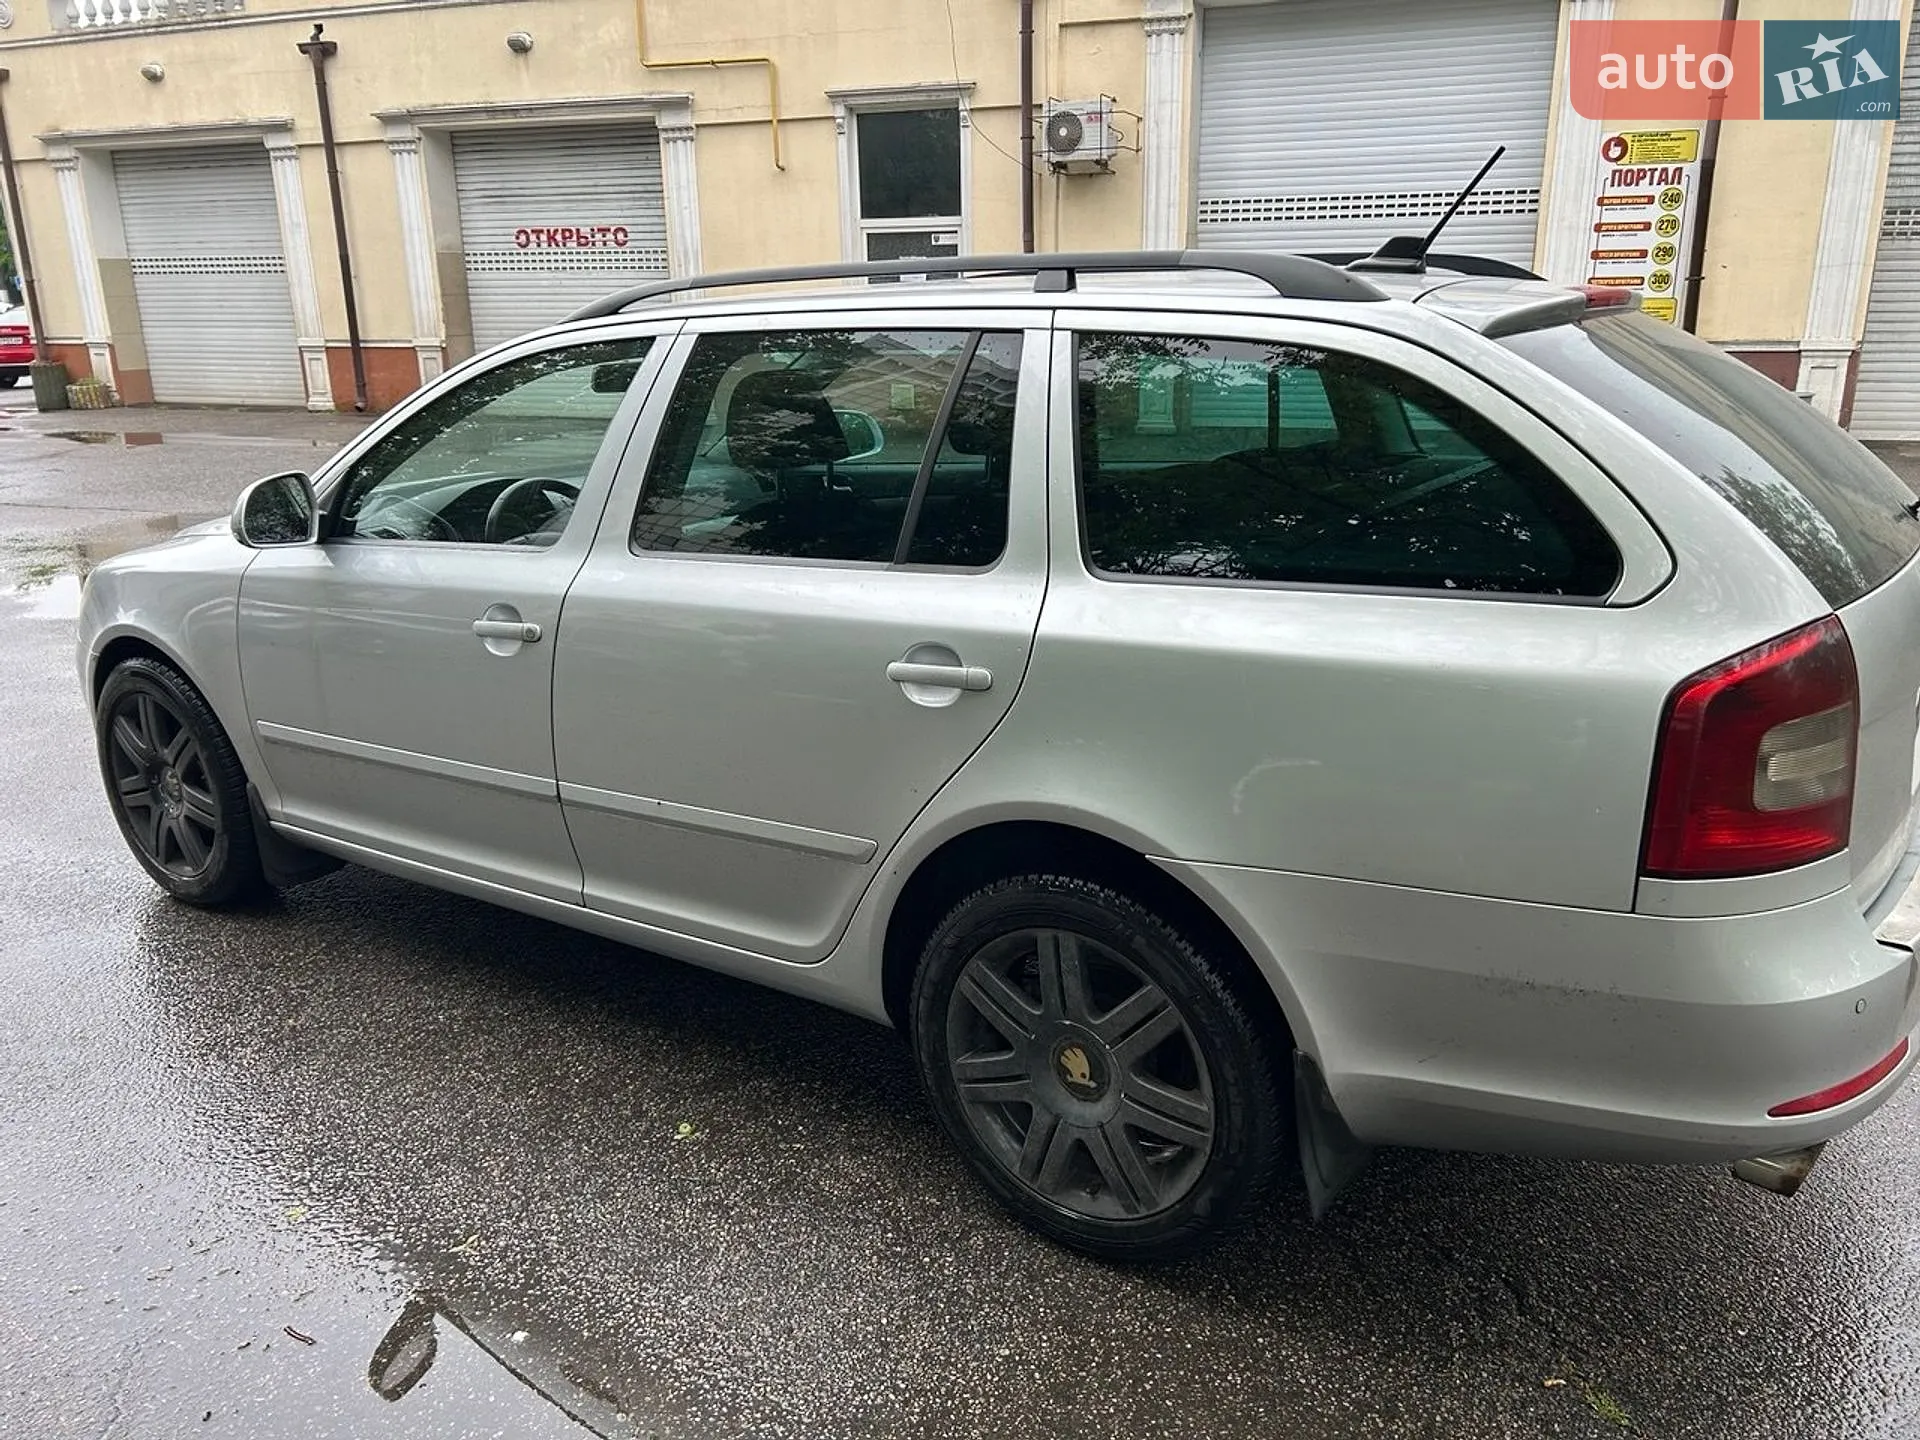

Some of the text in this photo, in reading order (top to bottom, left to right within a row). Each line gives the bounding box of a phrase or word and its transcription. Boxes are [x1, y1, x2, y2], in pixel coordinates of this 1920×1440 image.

[1610, 167, 1683, 188] ПОРТАЛ
[1662, 192, 1681, 204] 240
[1658, 219, 1677, 231] 270
[515, 226, 629, 249] ОТКРЫТО
[1655, 246, 1674, 258] 290
[1651, 274, 1670, 285] 300
